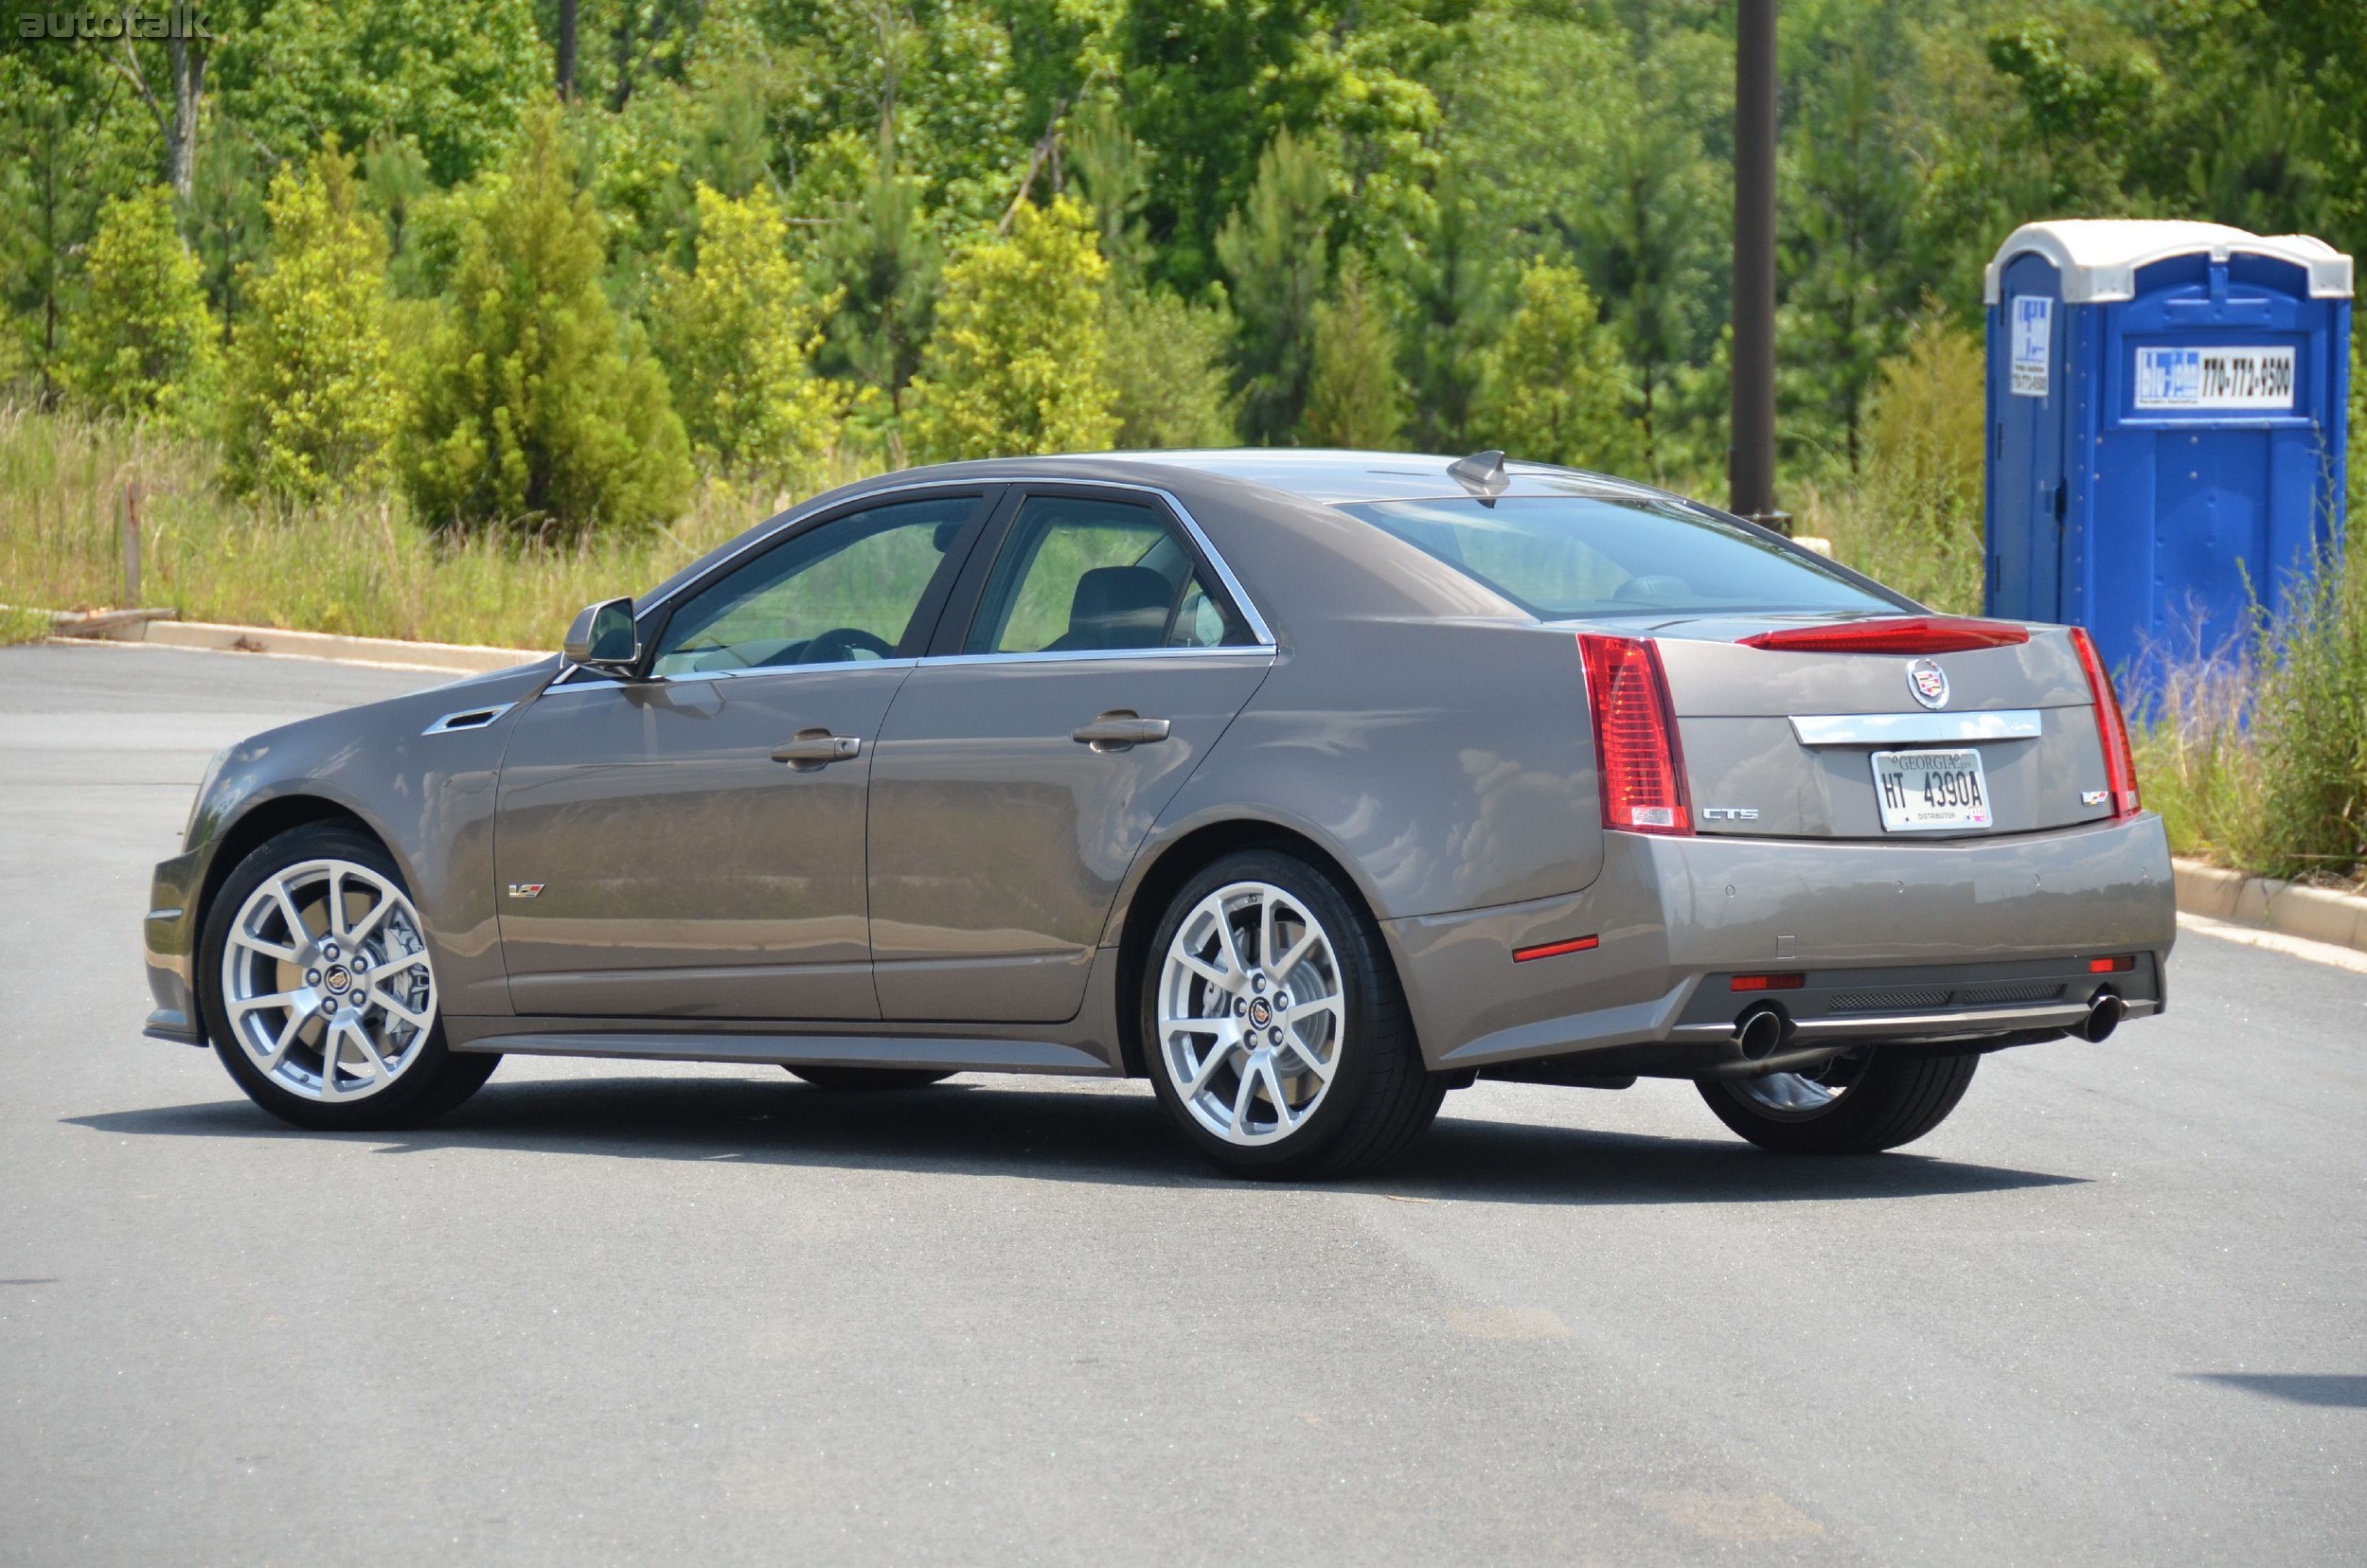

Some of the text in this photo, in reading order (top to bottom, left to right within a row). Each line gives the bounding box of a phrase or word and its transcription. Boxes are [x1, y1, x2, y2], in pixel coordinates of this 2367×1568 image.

[1881, 771, 1983, 809] HT 4390A
[1703, 808, 1758, 819] CTS
[1917, 812, 1956, 821] DISTRIBUTOR
